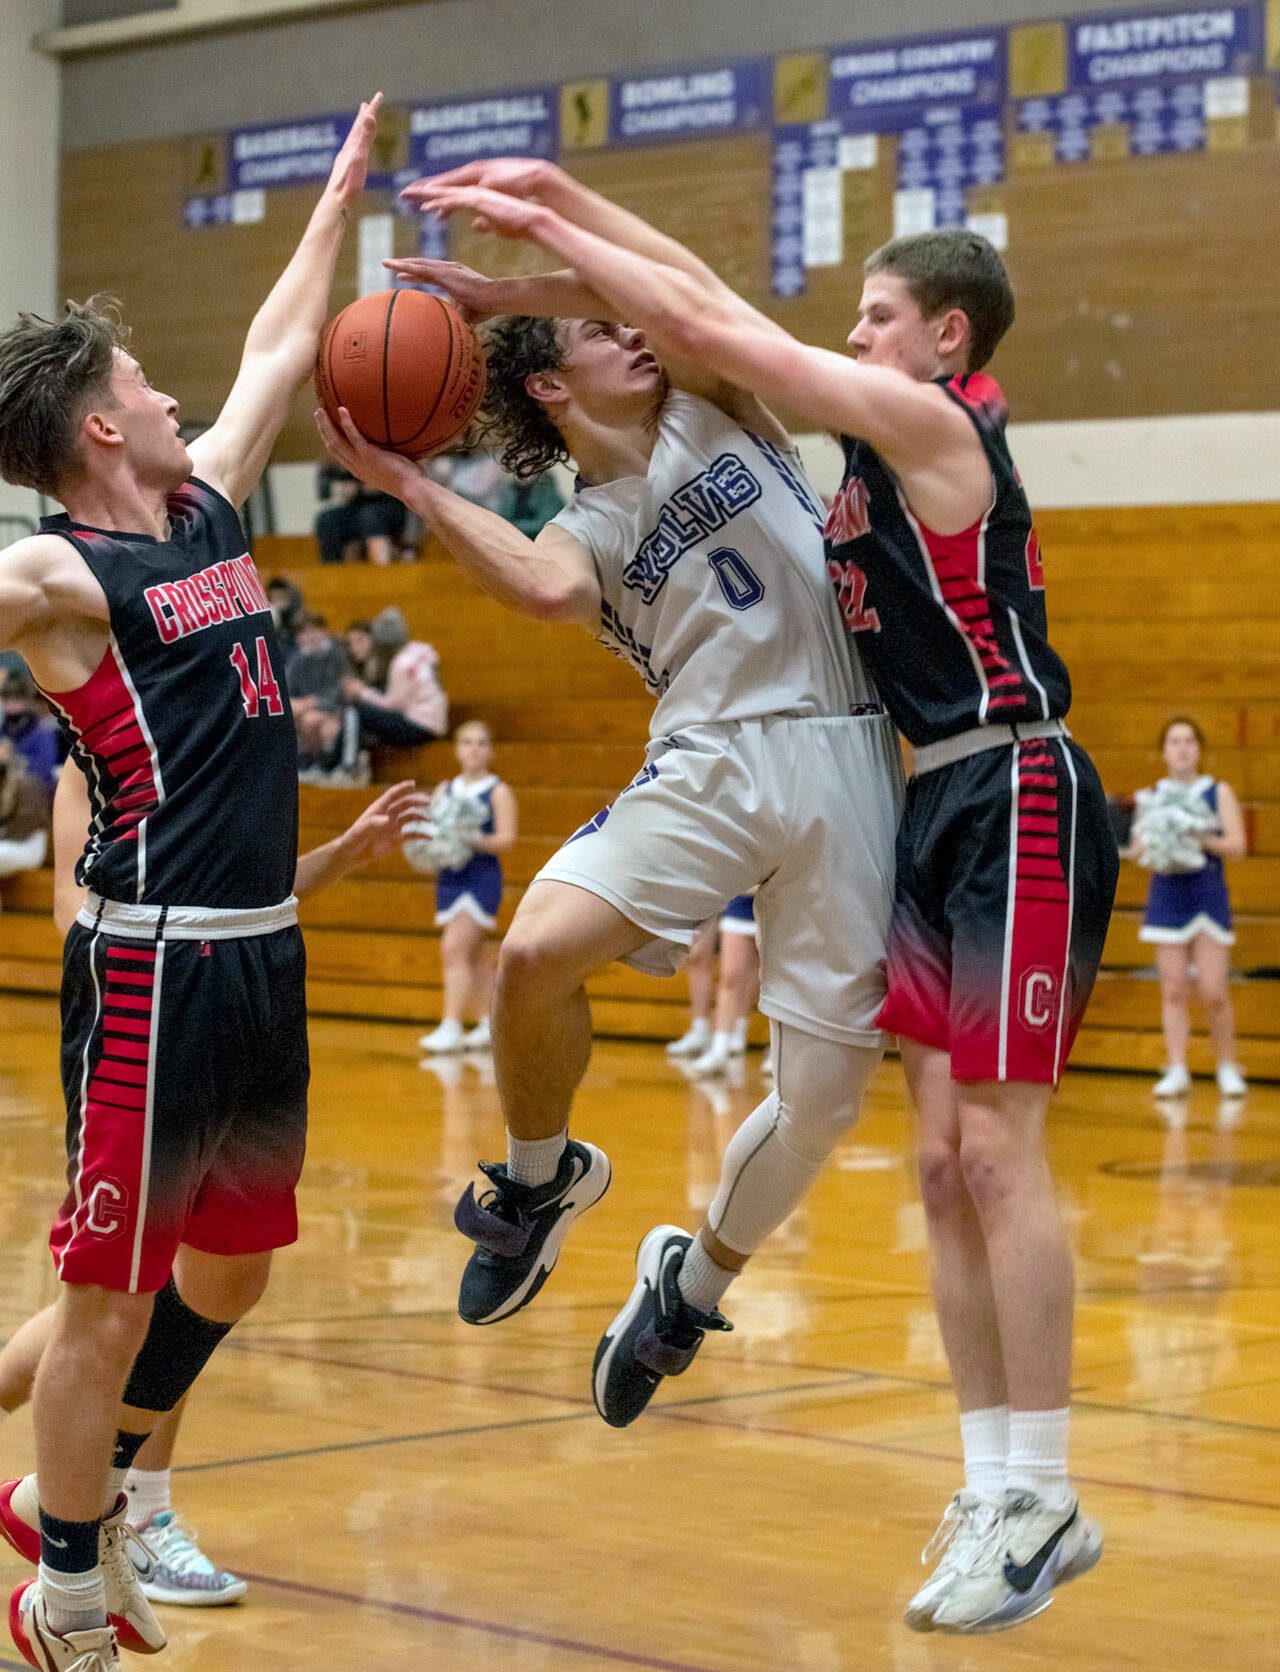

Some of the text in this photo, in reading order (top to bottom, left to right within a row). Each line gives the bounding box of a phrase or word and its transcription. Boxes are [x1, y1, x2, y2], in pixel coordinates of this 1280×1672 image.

[1076, 10, 1235, 55] FASTPITCH
[830, 39, 997, 79] CROSS COUNTRY
[1089, 43, 1225, 82] CHAMPIONS
[621, 70, 735, 108] BOWLING
[850, 67, 975, 105] CHAMPIONS
[410, 96, 548, 135] BASKETBALL
[621, 100, 735, 134] CHAMPIONS
[234, 122, 338, 159] BASEBALL
[425, 124, 532, 160] CHAMPIONS
[708, 546, 765, 611] 0
[229, 636, 285, 718] 14
[1021, 968, 1055, 1029] C
[87, 1177, 124, 1237] C
